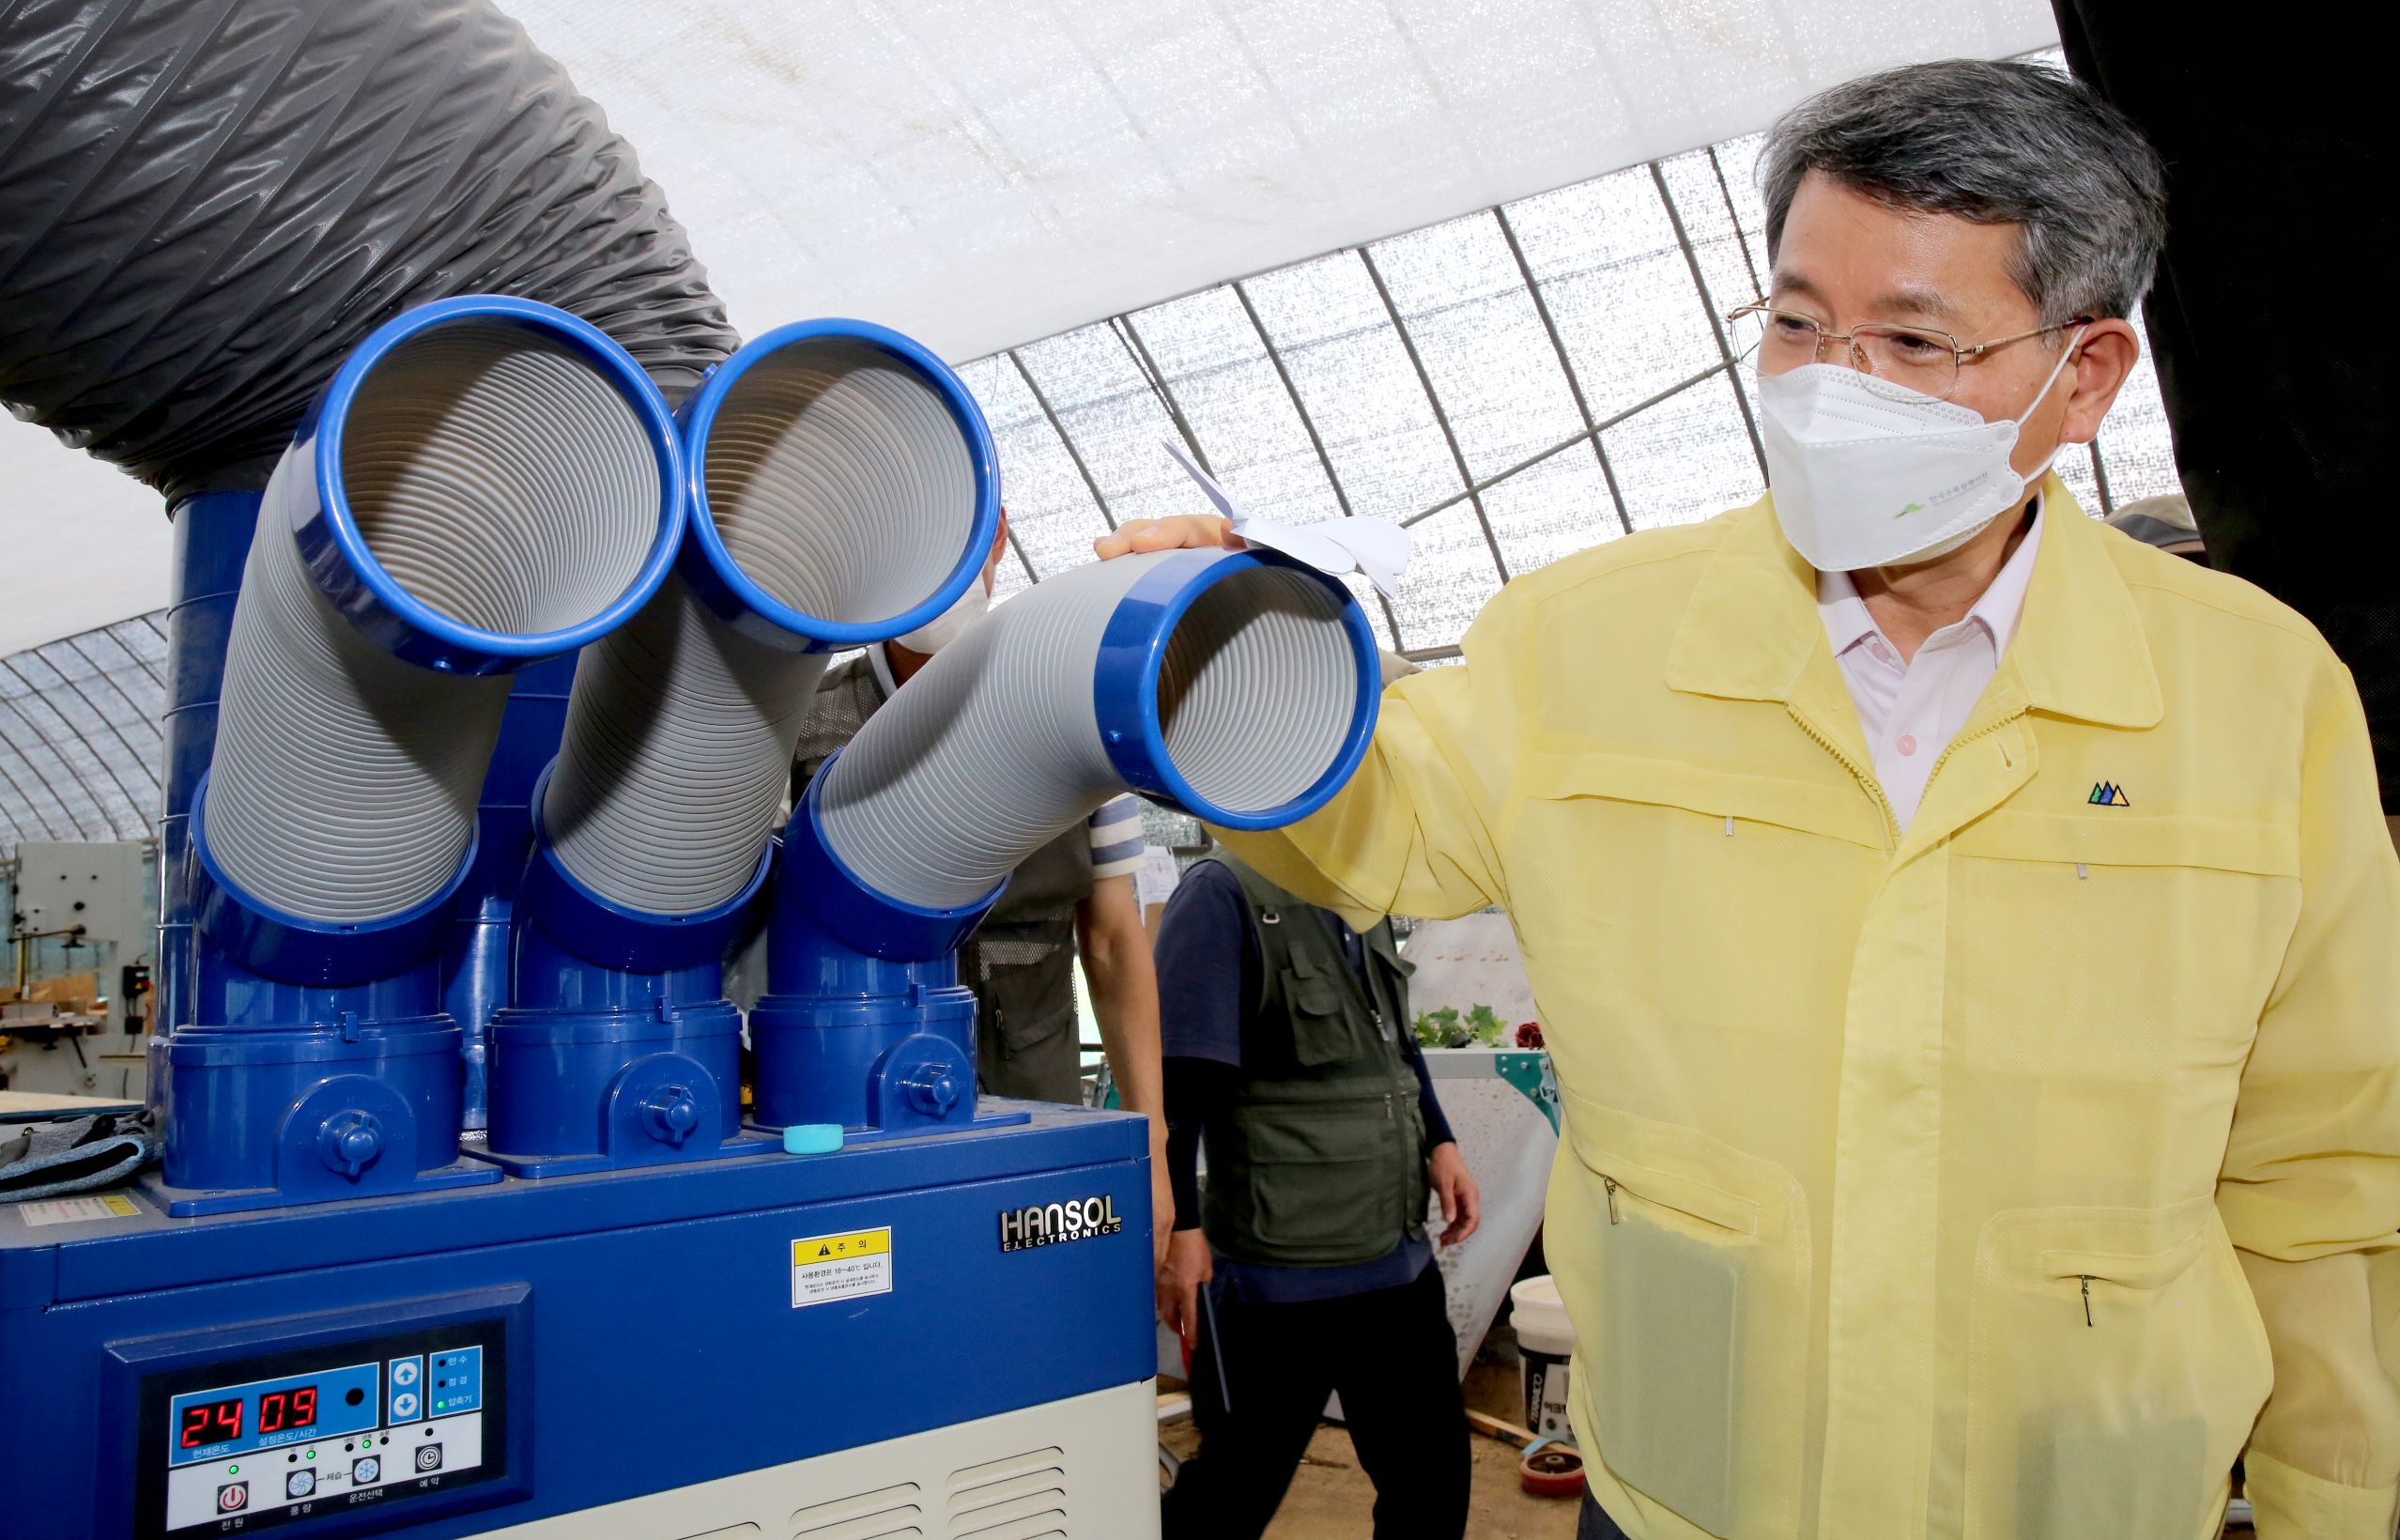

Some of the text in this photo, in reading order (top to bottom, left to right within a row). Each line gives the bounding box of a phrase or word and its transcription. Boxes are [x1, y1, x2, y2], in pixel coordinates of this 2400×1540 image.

[1001, 1194, 1121, 1241] HANSOL
[1003, 1224, 1121, 1252] ELECTRONICS
[802, 1269, 832, 1279] 사용환경은
[259, 1389, 317, 1432] 09
[181, 1403, 242, 1448] 24
[192, 1443, 230, 1459] 현재온도
[348, 1487, 383, 1503] 운전선택
